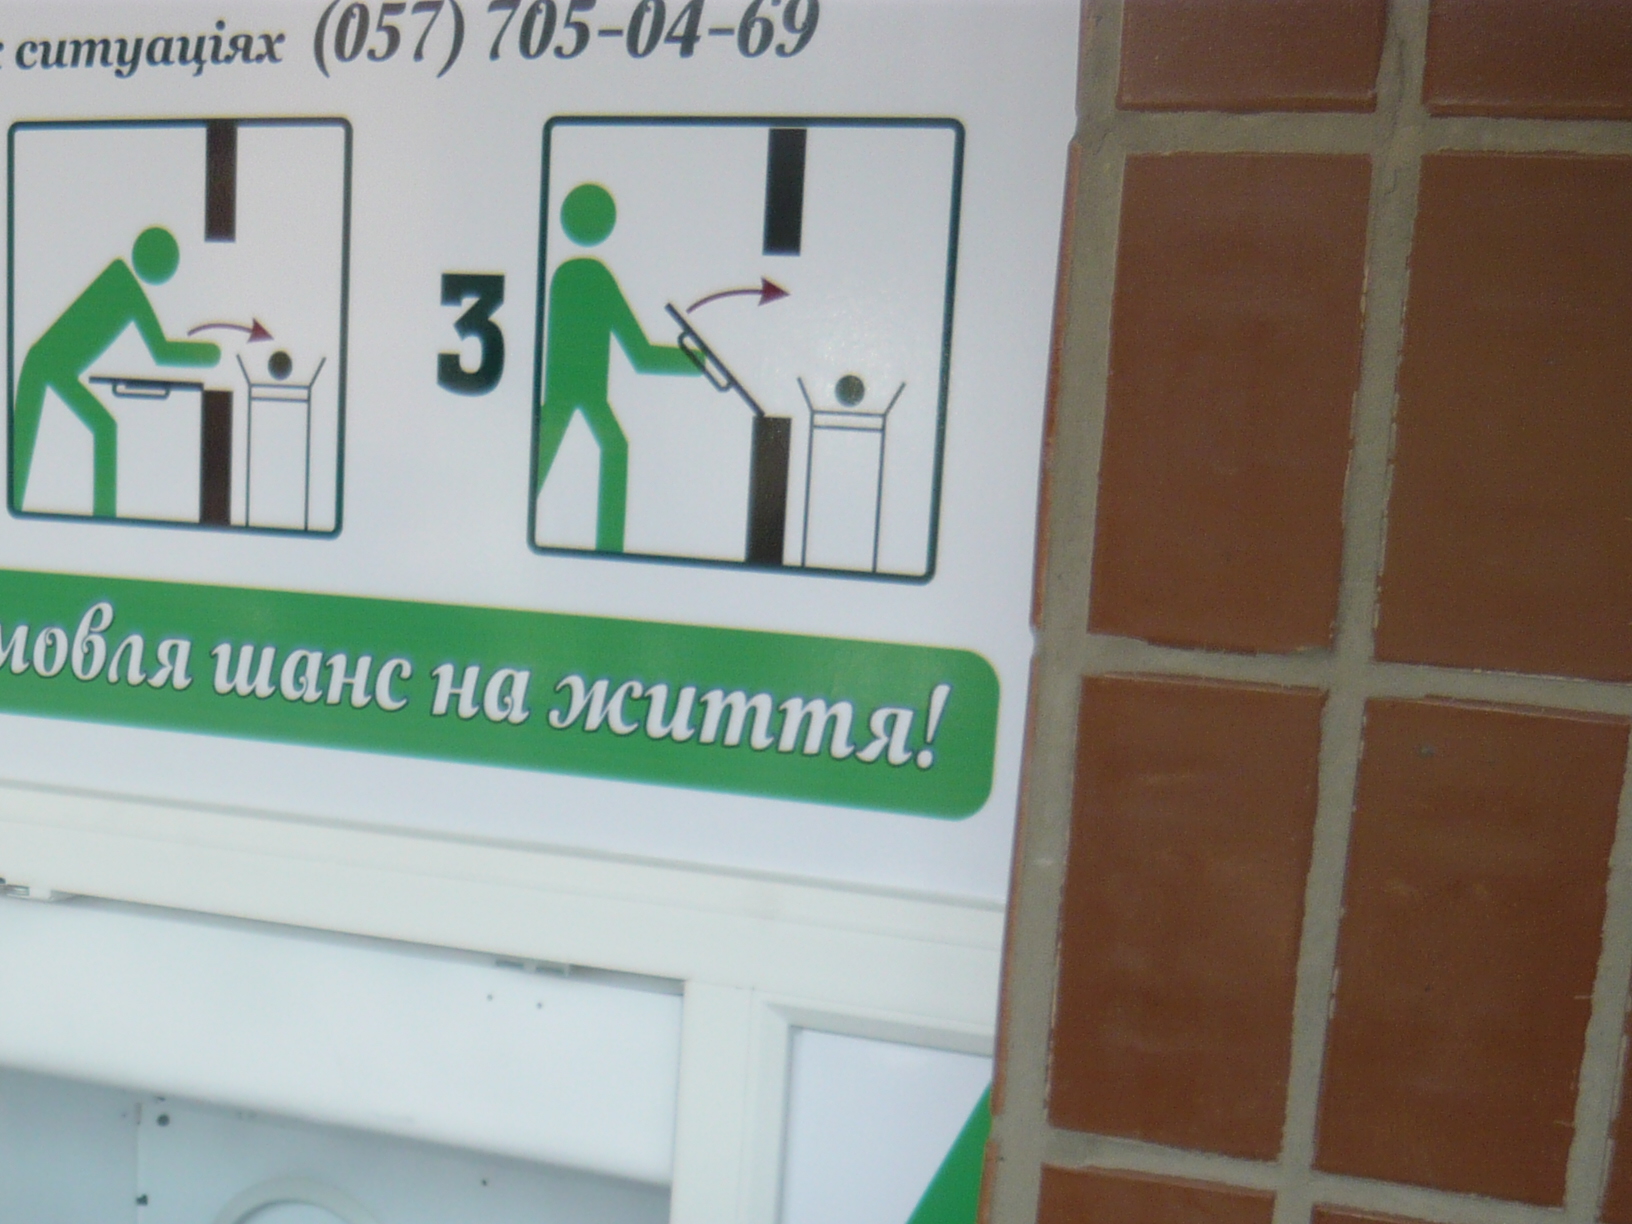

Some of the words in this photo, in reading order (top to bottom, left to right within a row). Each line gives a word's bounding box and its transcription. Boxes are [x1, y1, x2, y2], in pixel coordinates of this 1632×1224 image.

[14, 18, 287, 79] ситуаціях
[312, 0, 466, 78] (057)
[485, 0, 822, 62] 705-04-69
[436, 272, 507, 398] 3
[209, 639, 414, 713] шанс
[429, 659, 530, 727] на
[547, 671, 952, 771] життя!
